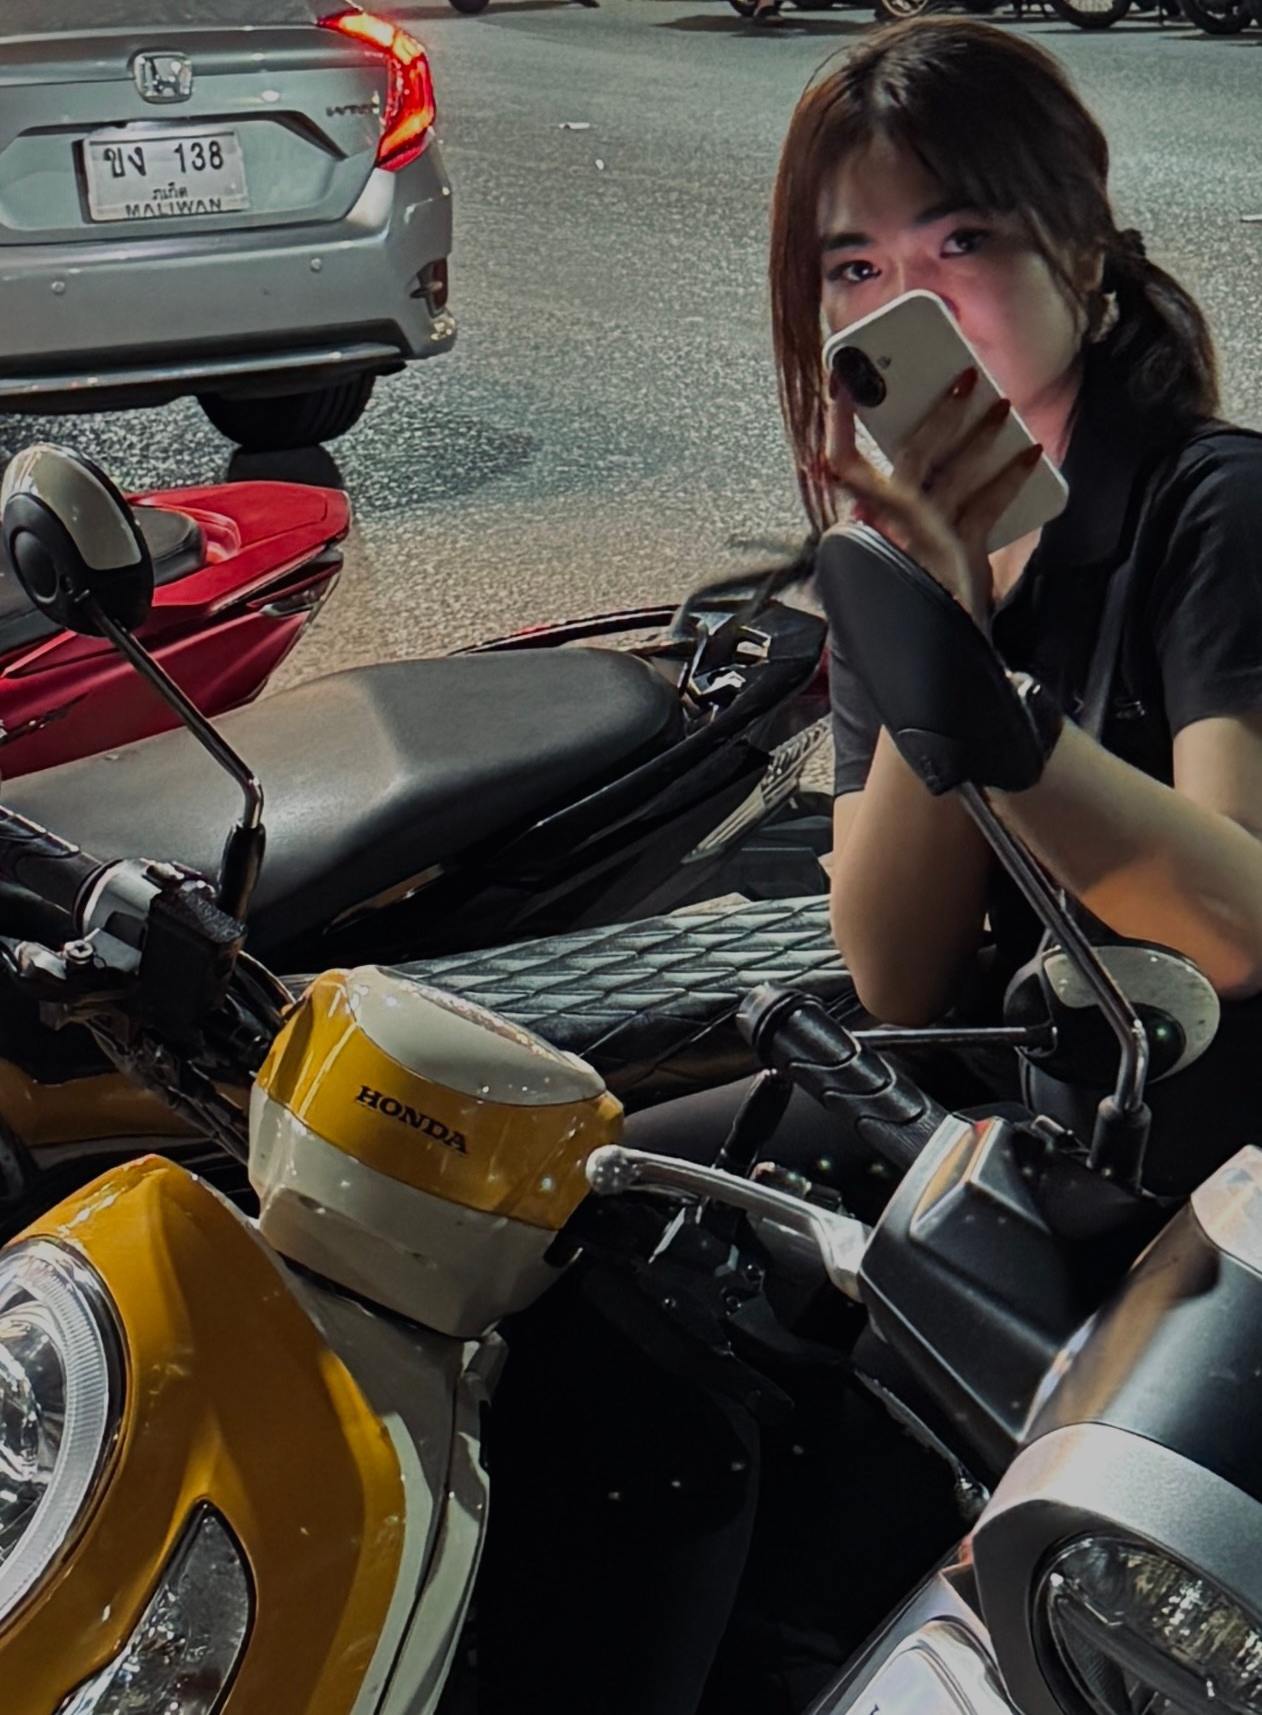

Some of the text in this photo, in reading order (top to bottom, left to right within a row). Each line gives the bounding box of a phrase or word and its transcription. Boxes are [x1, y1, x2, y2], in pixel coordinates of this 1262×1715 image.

[174, 140, 224, 173] 138
[125, 197, 222, 218] MALIWAN
[354, 1084, 468, 1155] HONDA
